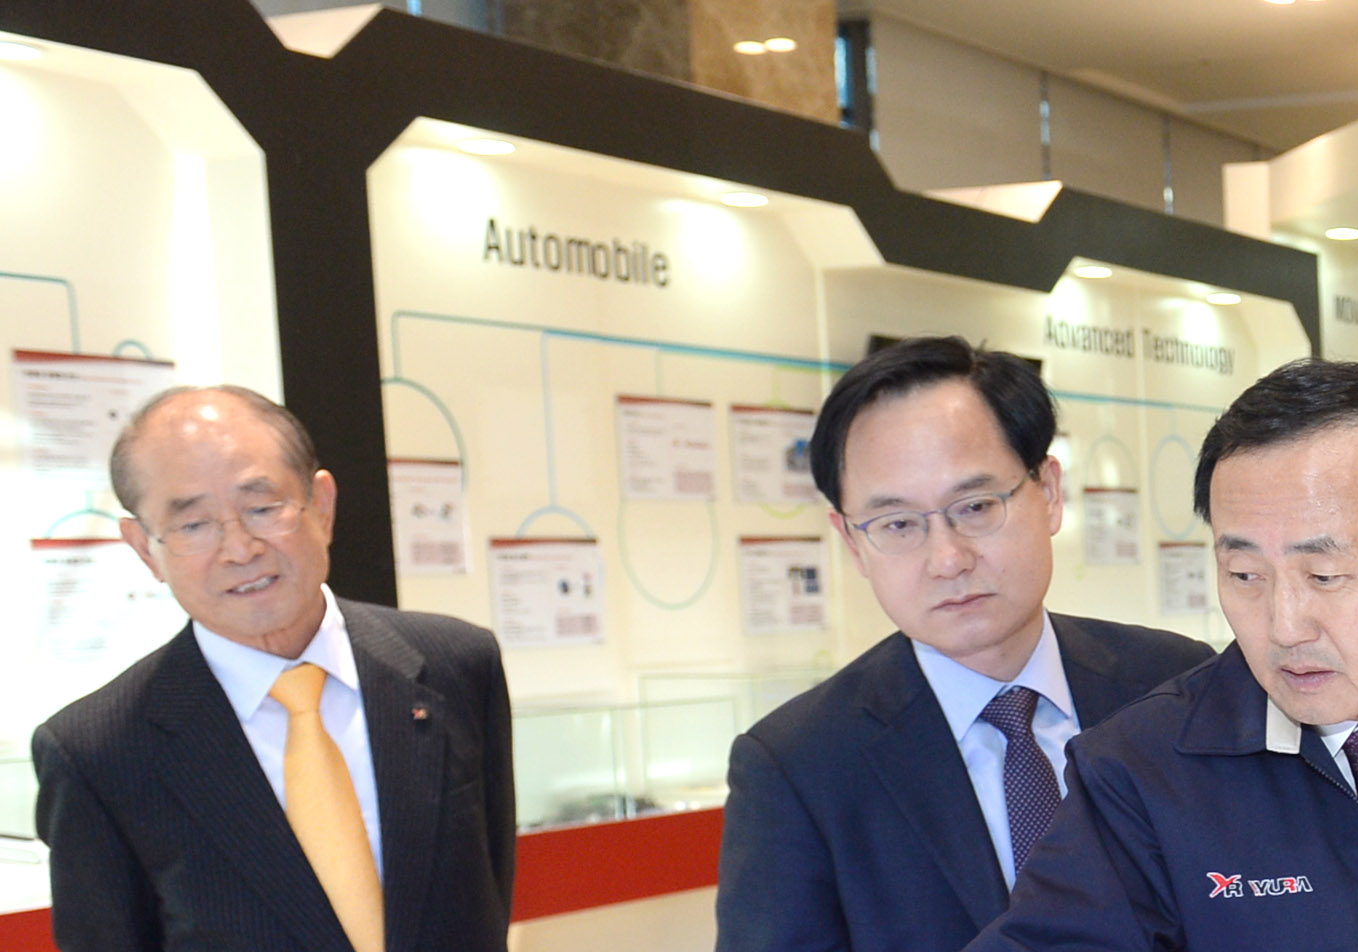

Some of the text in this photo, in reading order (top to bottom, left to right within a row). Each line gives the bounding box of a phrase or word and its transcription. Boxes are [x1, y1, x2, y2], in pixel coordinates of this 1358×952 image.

[483, 217, 670, 288] Automobile
[1044, 315, 1235, 376] Advanced Technology
[1247, 876, 1313, 896] YURA
